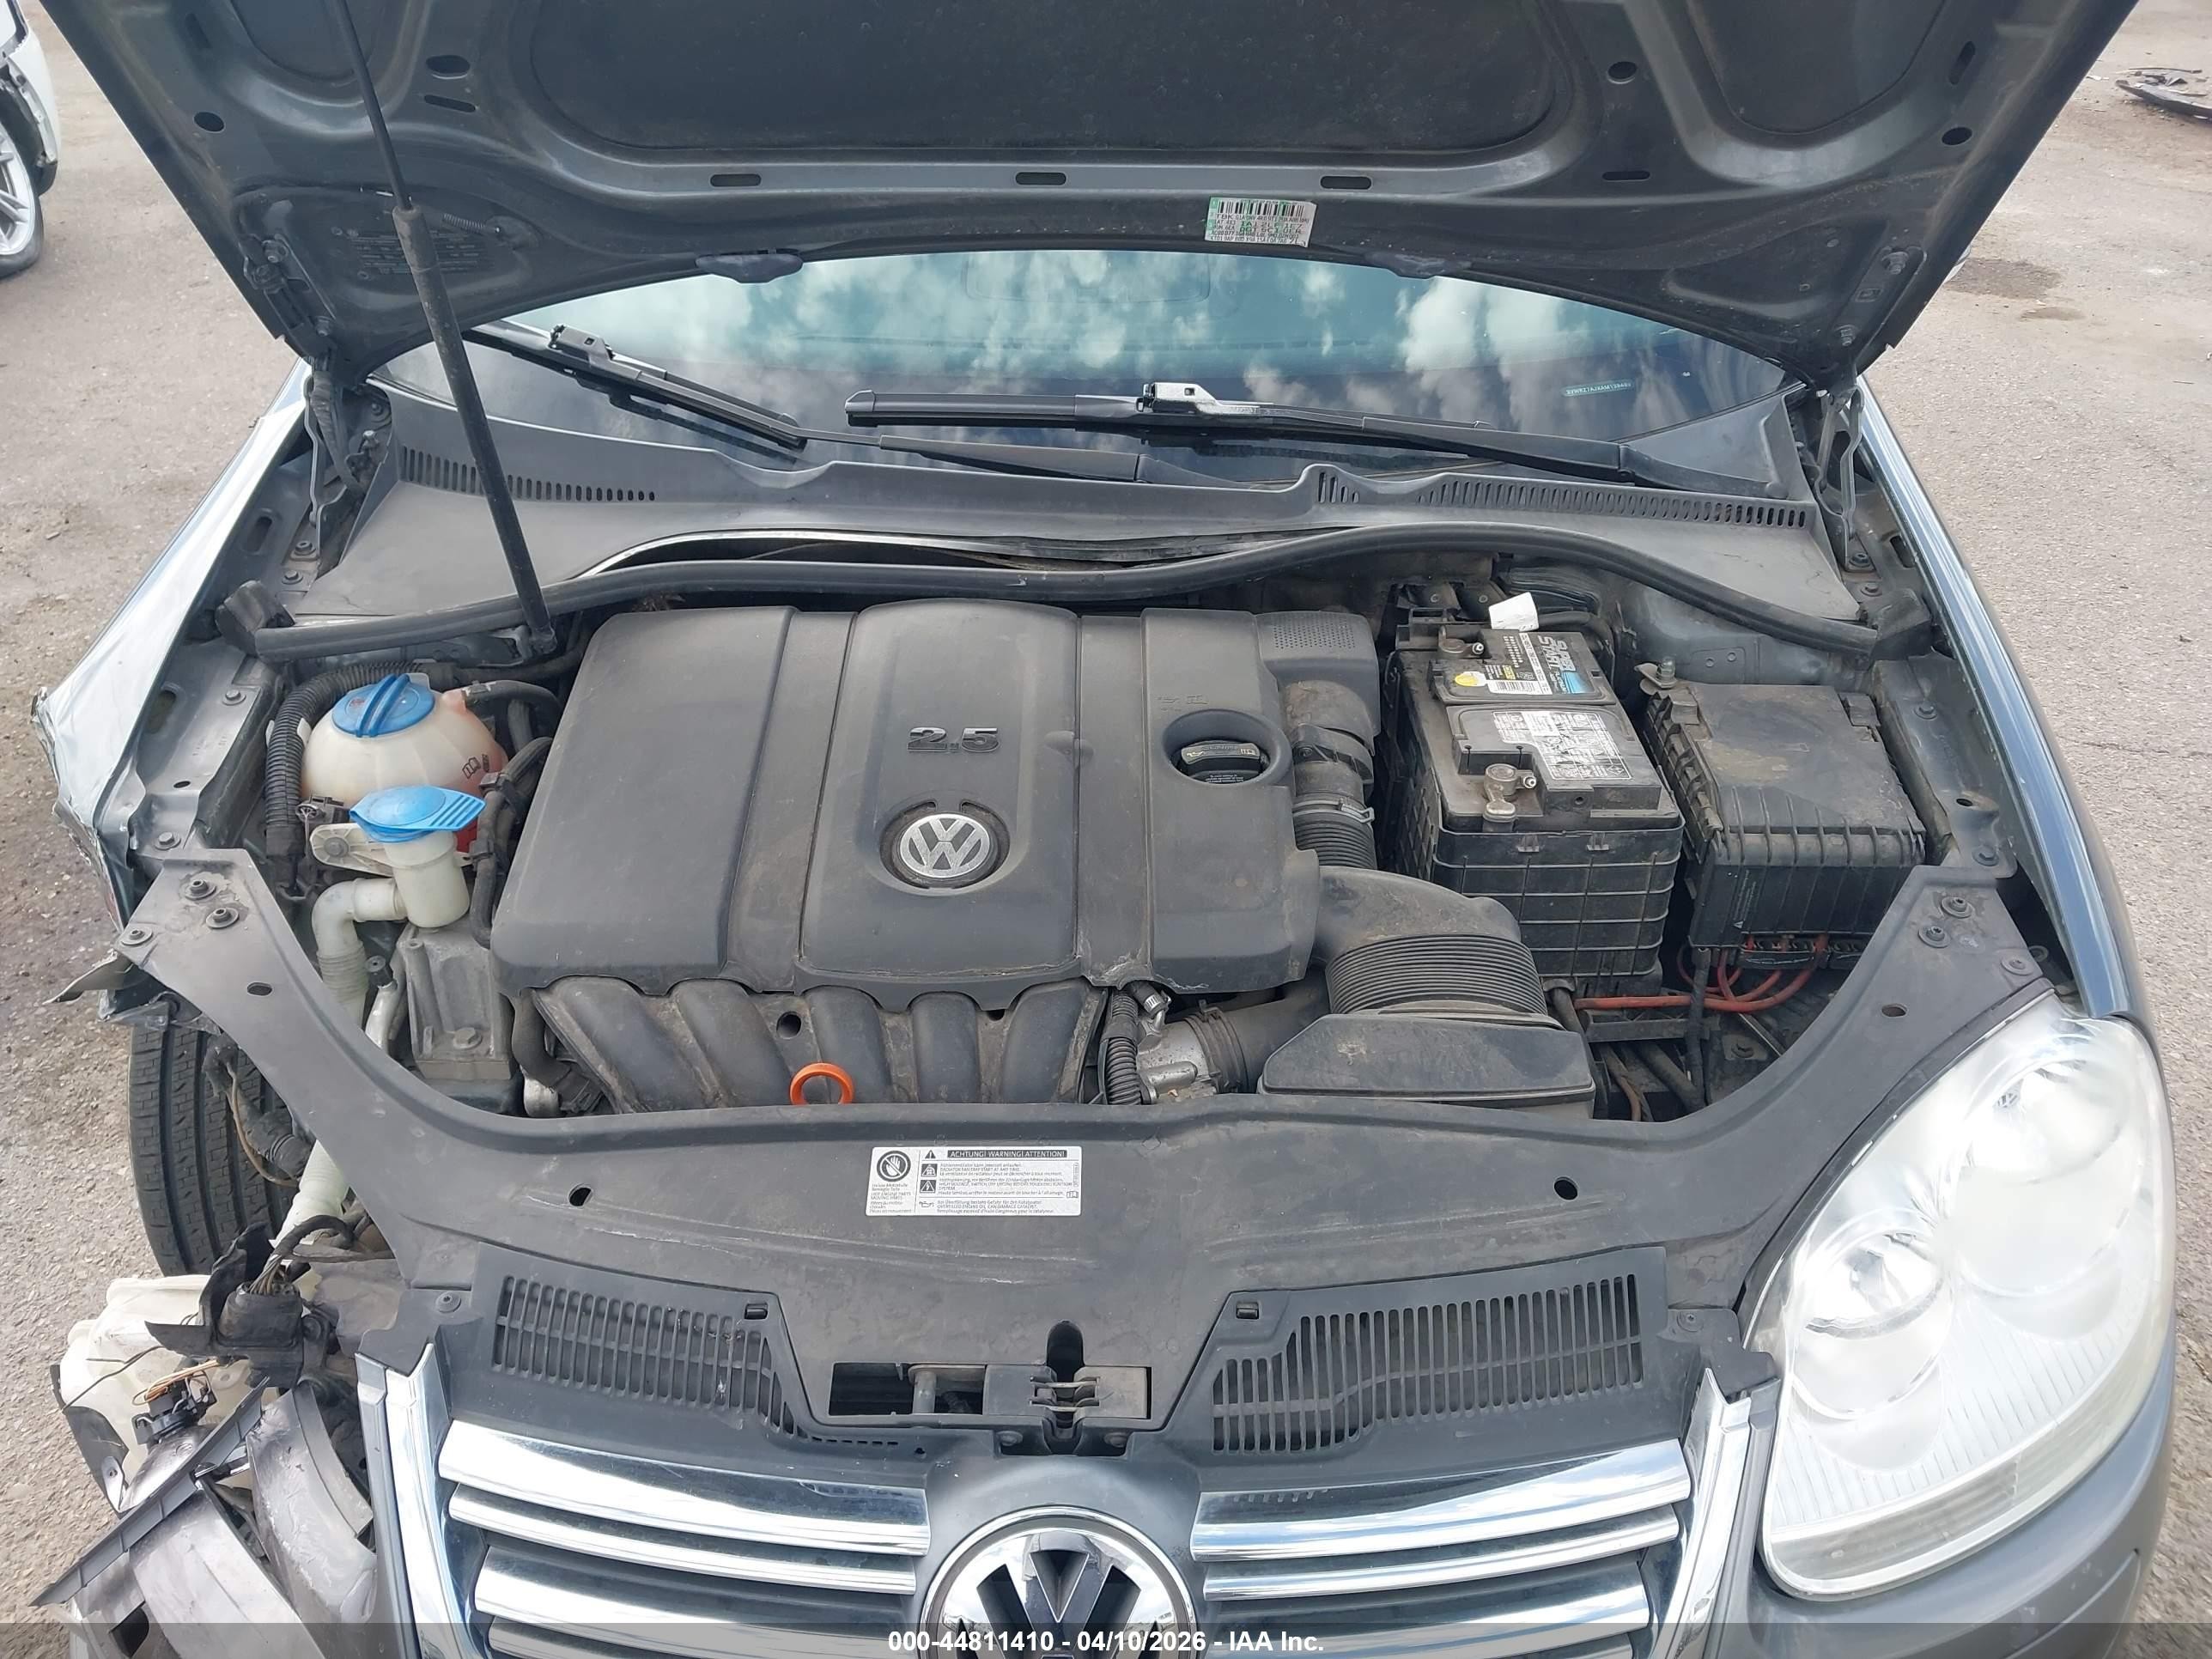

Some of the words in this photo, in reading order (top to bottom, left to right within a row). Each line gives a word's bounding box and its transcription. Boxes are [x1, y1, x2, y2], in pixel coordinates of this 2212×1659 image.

[1537, 635, 1562, 671] START
[1555, 640, 1577, 672] SUPER
[907, 726, 1000, 753] 2.5
[900, 813, 990, 878] VW
